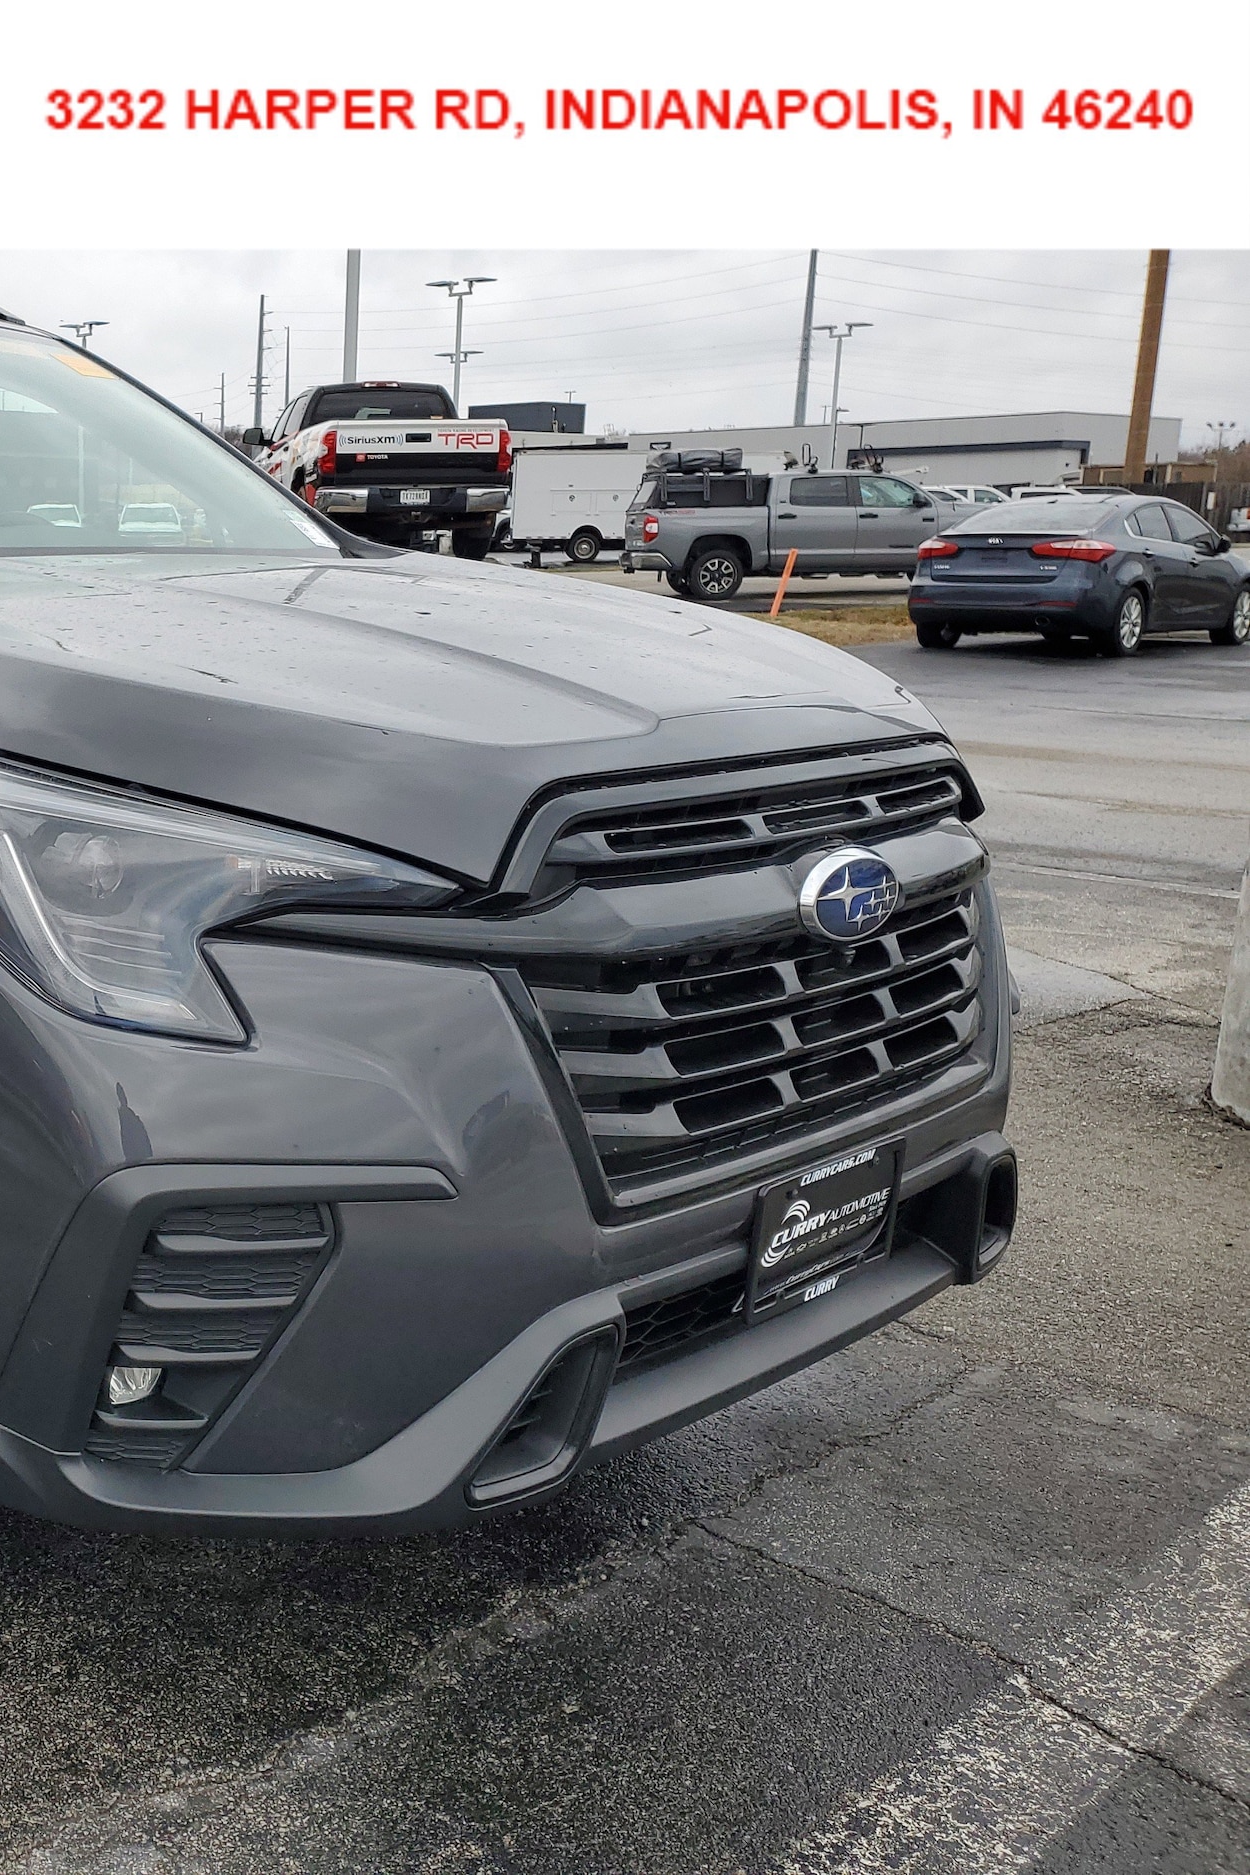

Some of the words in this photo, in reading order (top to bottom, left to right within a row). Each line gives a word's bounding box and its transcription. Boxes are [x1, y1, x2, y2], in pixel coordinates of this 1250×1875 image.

[437, 432, 494, 450] TRD
[800, 1149, 876, 1187] CURRYCARS.COM
[771, 1209, 833, 1248] CURRY
[826, 1187, 891, 1224] AUTOMOTIVE
[804, 1275, 840, 1302] CURRY
